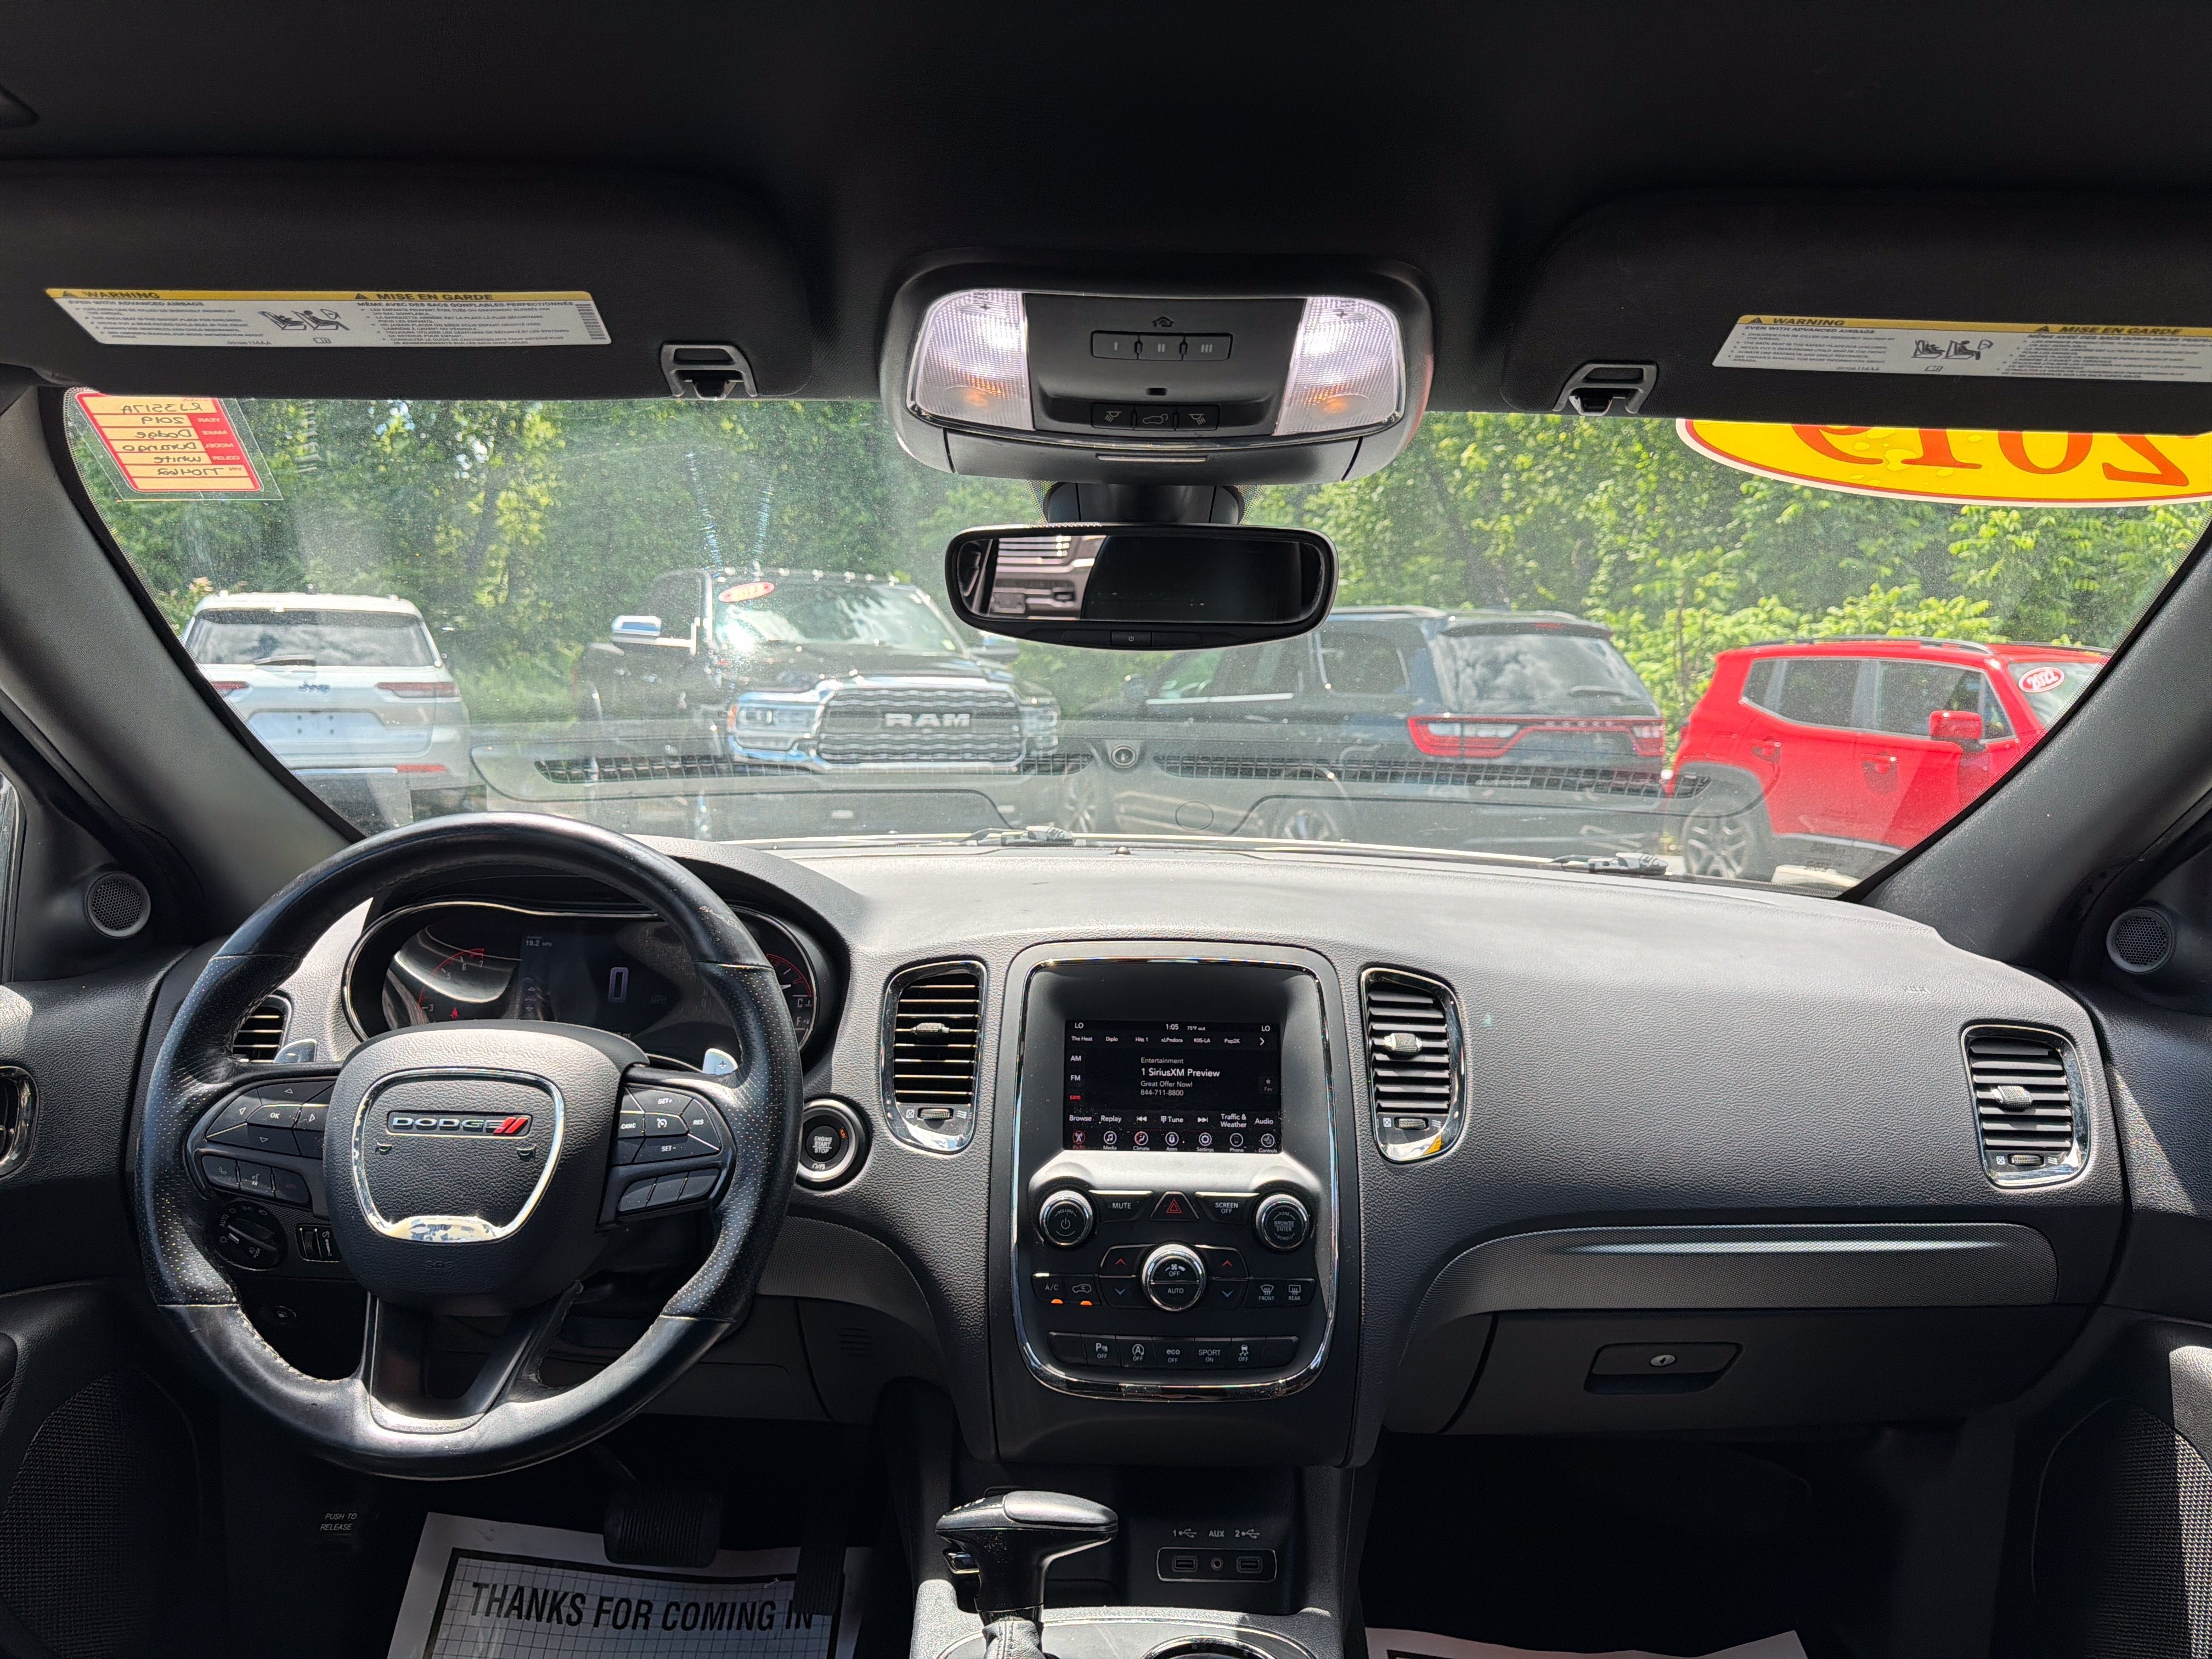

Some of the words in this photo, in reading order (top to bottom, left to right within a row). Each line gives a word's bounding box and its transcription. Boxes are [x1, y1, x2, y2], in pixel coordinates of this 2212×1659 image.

[885, 713, 970, 727] RAM
[461, 963, 467, 971] 6
[607, 966, 630, 1003] 0
[797, 998, 803, 1008] C
[796, 1017, 802, 1025] F
[1148, 1068, 1184, 1077] SiriusXM
[1187, 1069, 1221, 1077] Preview
[392, 1116, 506, 1131] DODGE
[218, 1214, 230, 1228] AUTO
[1208, 1530, 1225, 1538] AUX
[1234, 1530, 1240, 1538] 2
[470, 1582, 586, 1627] THANKS
[593, 1596, 654, 1631] FOR
[662, 1600, 777, 1632] COMING
[785, 1600, 814, 1630] IN
